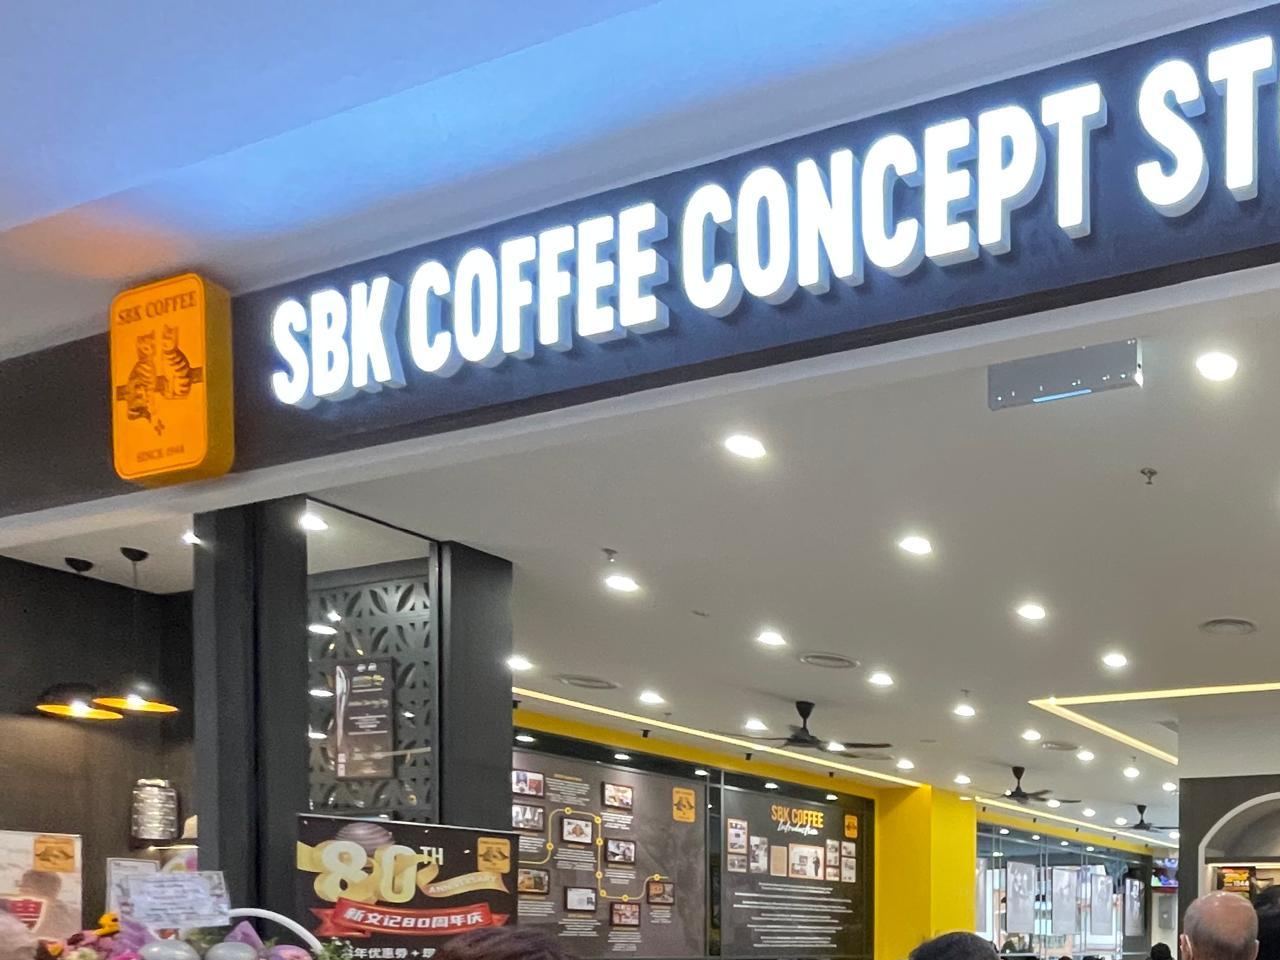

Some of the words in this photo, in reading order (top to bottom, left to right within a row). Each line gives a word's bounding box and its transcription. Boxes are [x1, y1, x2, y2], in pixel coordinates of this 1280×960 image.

[272, 276, 394, 406] SBK
[409, 202, 660, 373] COFFEE
[682, 83, 1104, 310] CONCEPT
[117, 305, 142, 325] SBK
[145, 291, 197, 318] COFFEE
[771, 804, 790, 821] SBK
[792, 808, 825, 828] COFFEE
[343, 907, 484, 929] 新文记80周年庆
